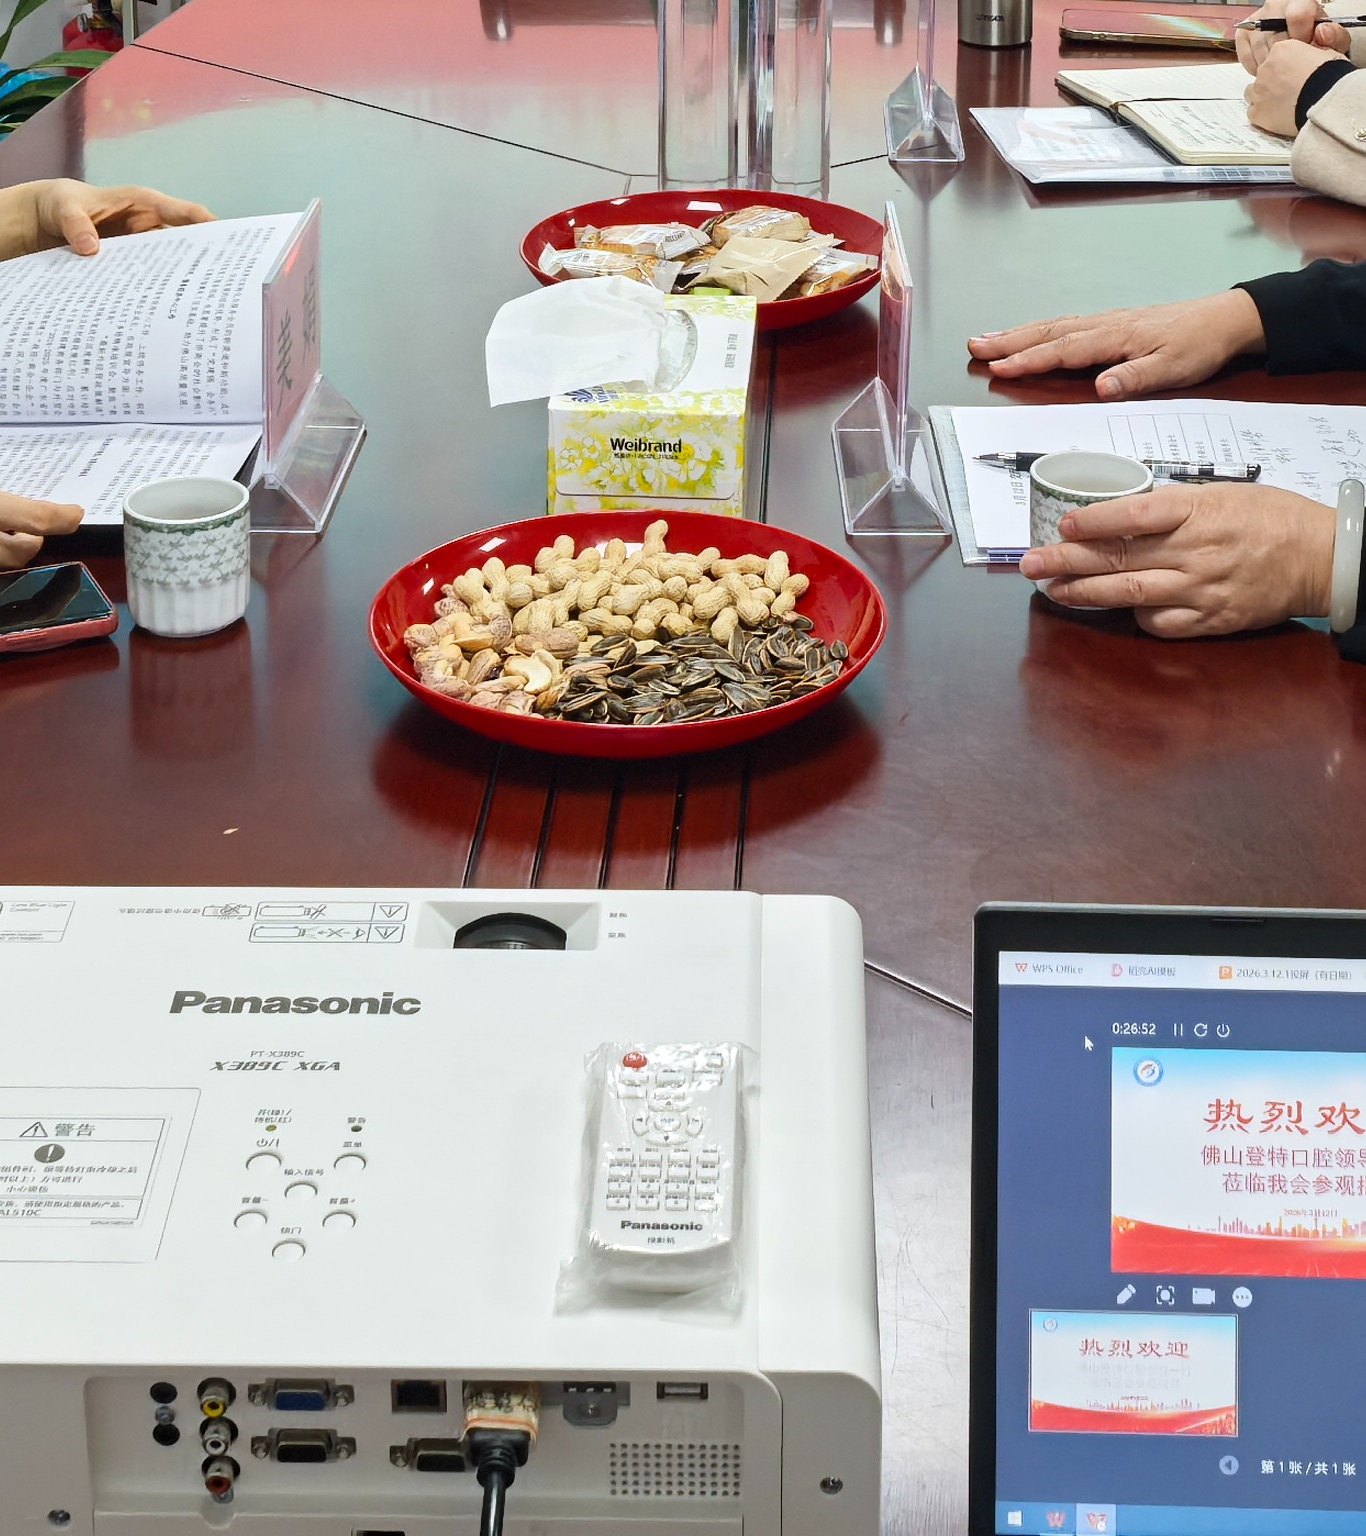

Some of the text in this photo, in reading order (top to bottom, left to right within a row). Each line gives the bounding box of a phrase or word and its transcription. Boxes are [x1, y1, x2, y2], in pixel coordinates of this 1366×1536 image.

[610, 437, 682, 453] Weibrand
[1032, 963, 1084, 975] WPS Office
[169, 990, 422, 1016] Panasonic
[1111, 1022, 1157, 1037] 0:26:52
[293, 1061, 341, 1072] XGA
[54, 1122, 97, 1138] 警告
[620, 1220, 704, 1232] Panasonic
[1078, 1338, 1190, 1359] 热烈欢迎
